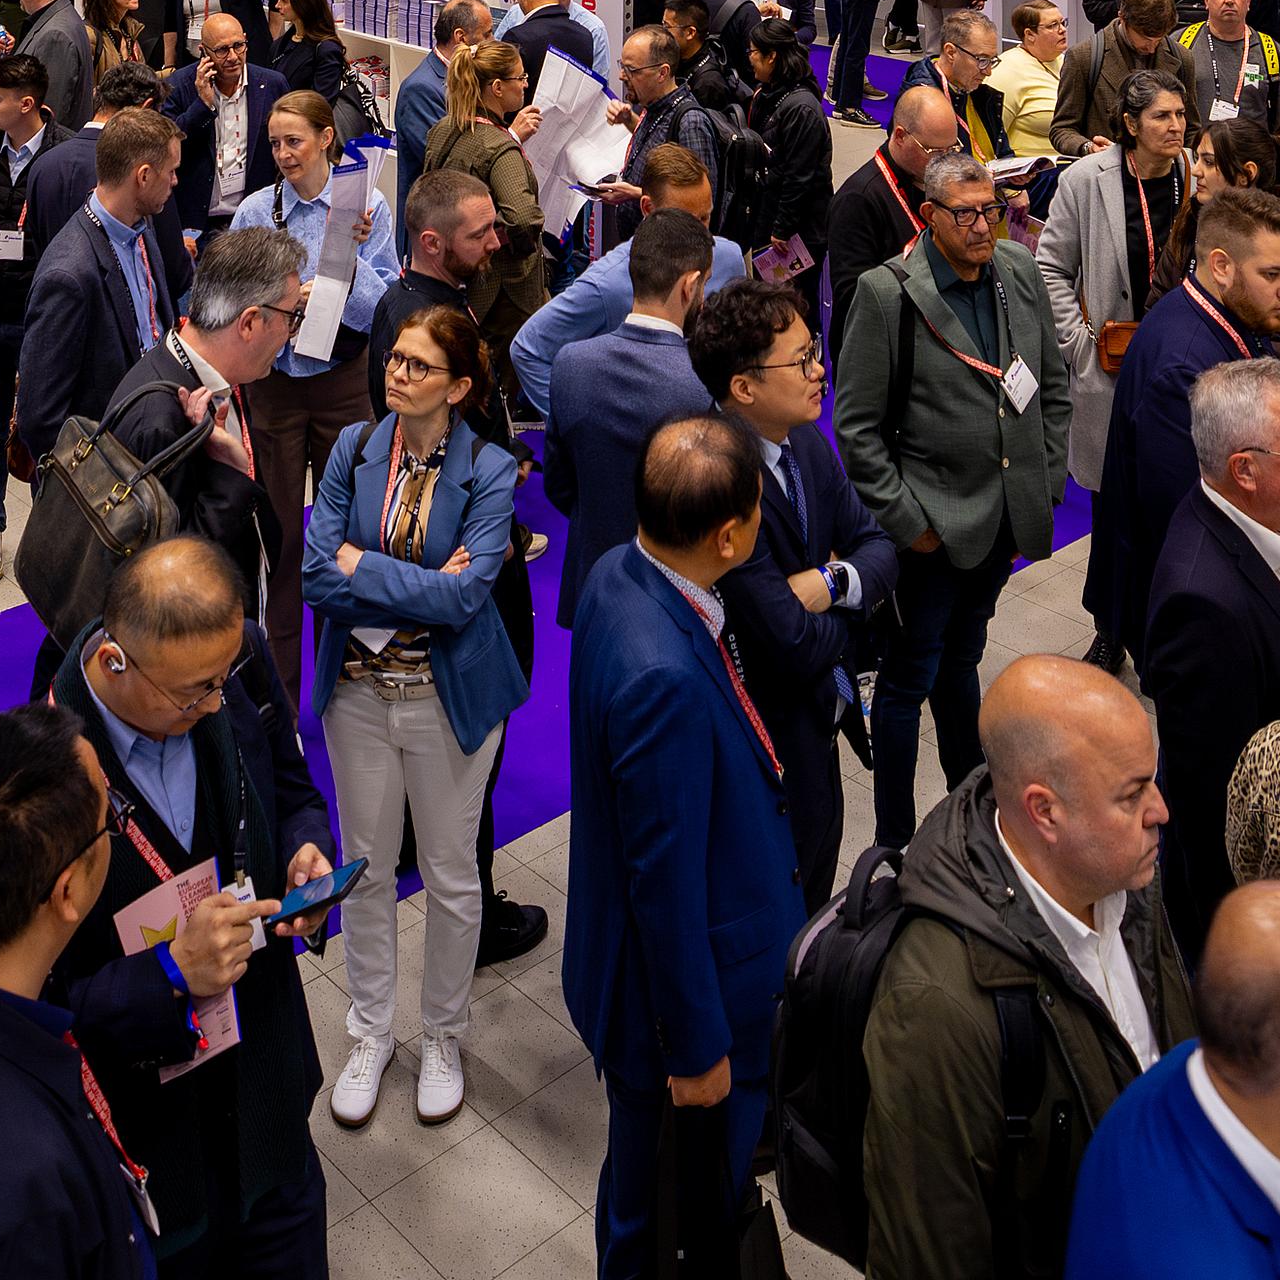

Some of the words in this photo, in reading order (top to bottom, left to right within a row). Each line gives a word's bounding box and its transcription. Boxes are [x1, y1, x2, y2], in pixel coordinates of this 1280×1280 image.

[728, 634, 746, 683] NEXARO
[176, 879, 190, 890] THE
[179, 875, 213, 897] EUROPEAN
